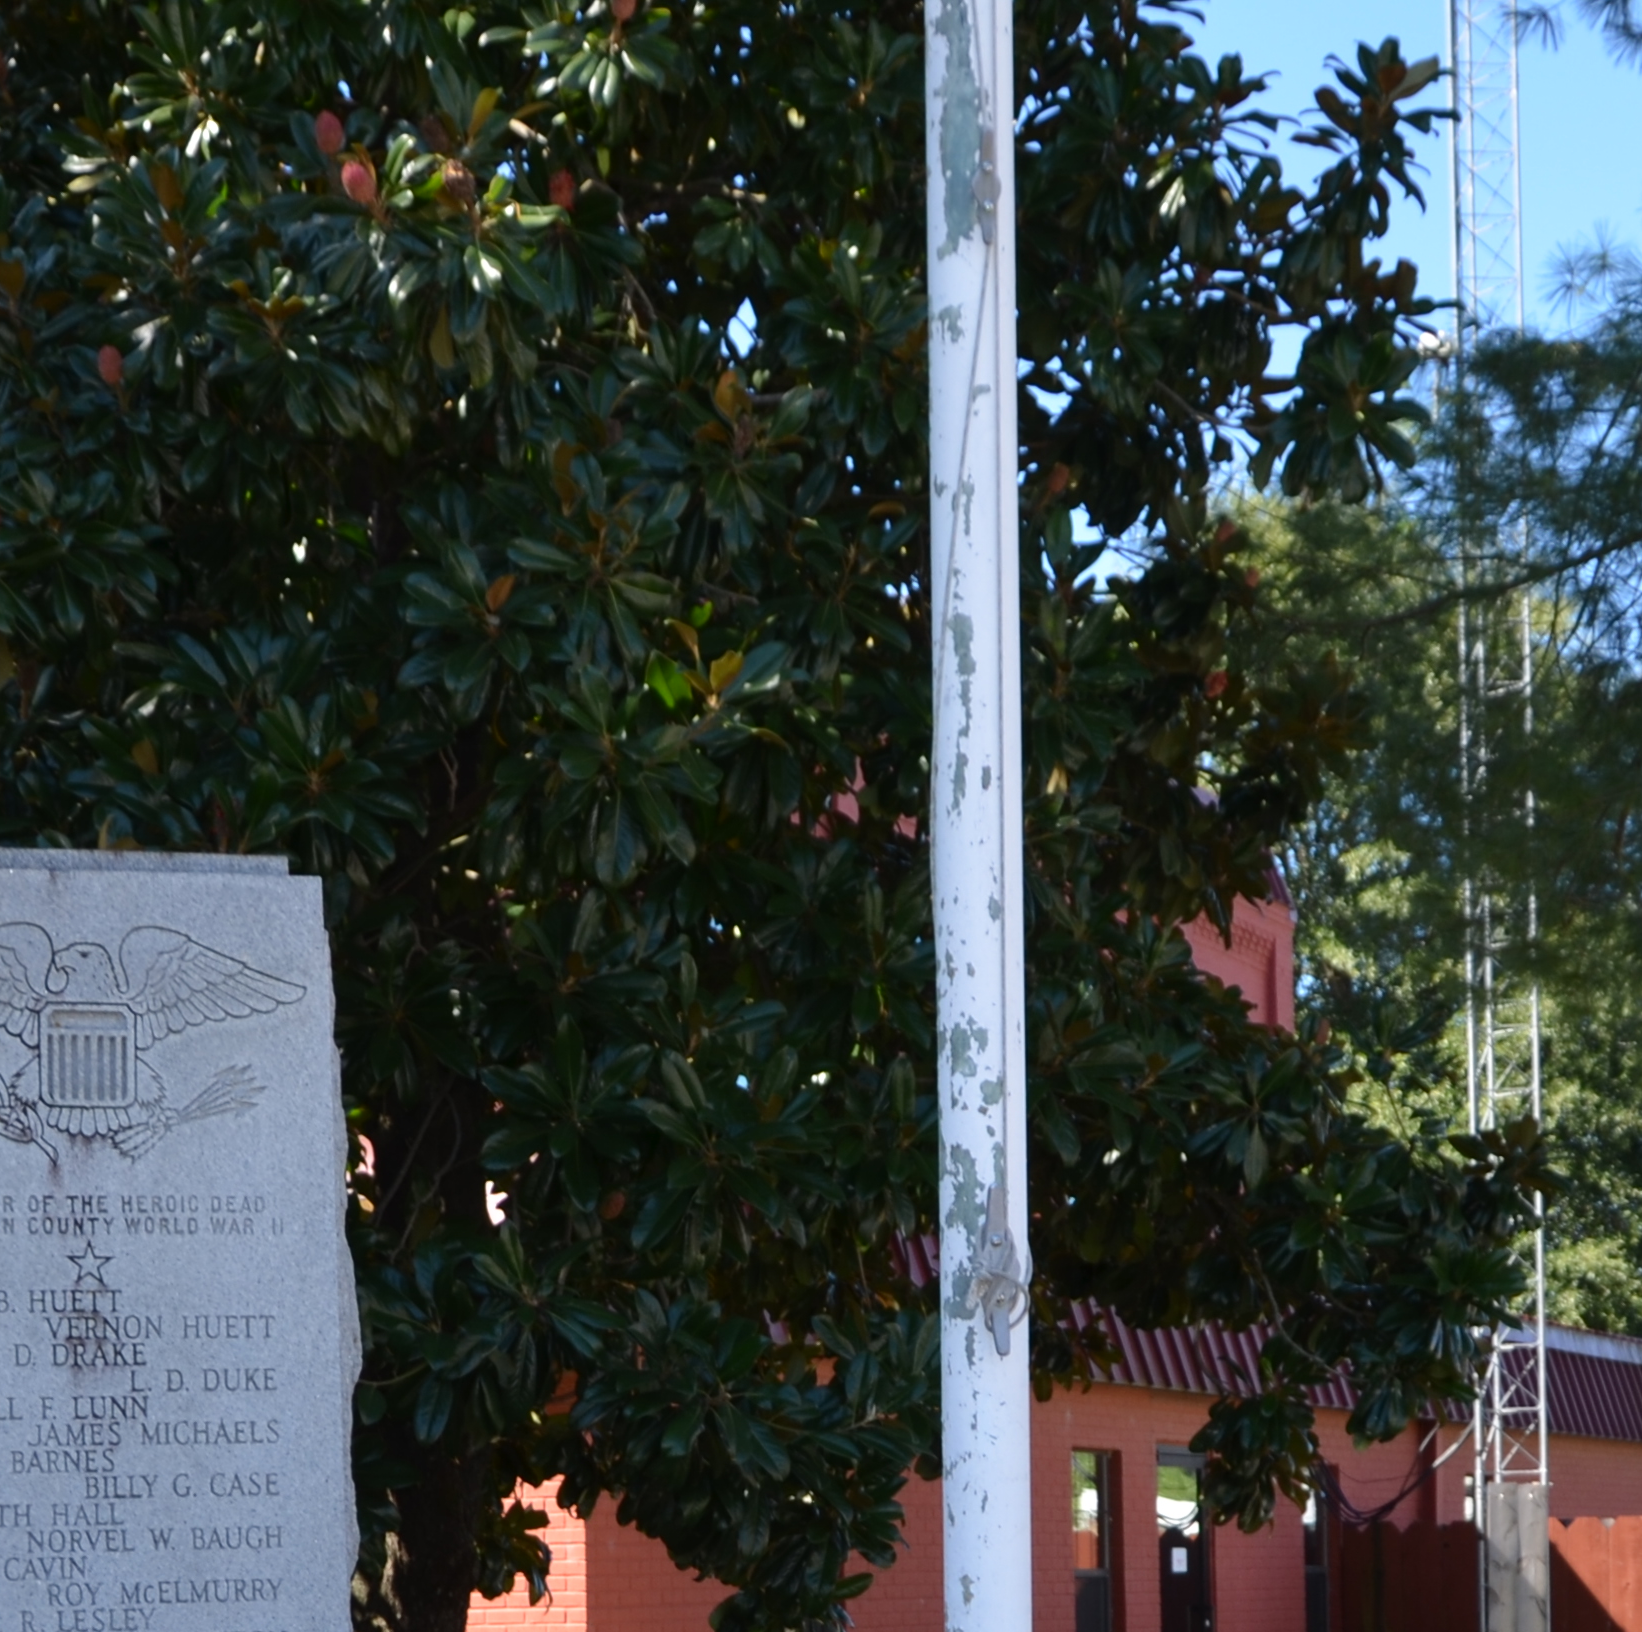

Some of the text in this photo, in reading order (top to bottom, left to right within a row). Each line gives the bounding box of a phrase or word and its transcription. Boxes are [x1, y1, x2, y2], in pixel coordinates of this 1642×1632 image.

[29, 1195, 57, 1214] OF
[69, 1195, 108, 1214] THE
[121, 1195, 199, 1214] HEROIC
[211, 1195, 266, 1214] DEAD
[28, 1217, 113, 1236] COUNTY
[124, 1217, 199, 1236] WORLD
[210, 1217, 254, 1236] WAR
[270, 1218, 285, 1236] II
[29, 1289, 122, 1313] HUETT
[46, 1314, 275, 1340] VERNON HUETT
[14, 1344, 37, 1367] D.
[51, 1343, 147, 1367] DRAKE
[129, 1368, 277, 1393] L. D. DUKE
[41, 1397, 60, 1420] F.
[73, 1397, 149, 1420] LUNN
[27, 1420, 280, 1447] JAMES MICHAELS
[11, 1450, 116, 1473] BARNES
[84, 1473, 279, 1499] BILLY G. CASE
[52, 1503, 124, 1527] HALL
[27, 1526, 284, 1554] NORVEL W. BAUGH
[3, 1556, 89, 1581] CAVIN
[48, 1579, 283, 1607] ROY McELMURRY
[56, 1609, 156, 1632] LESLEY
